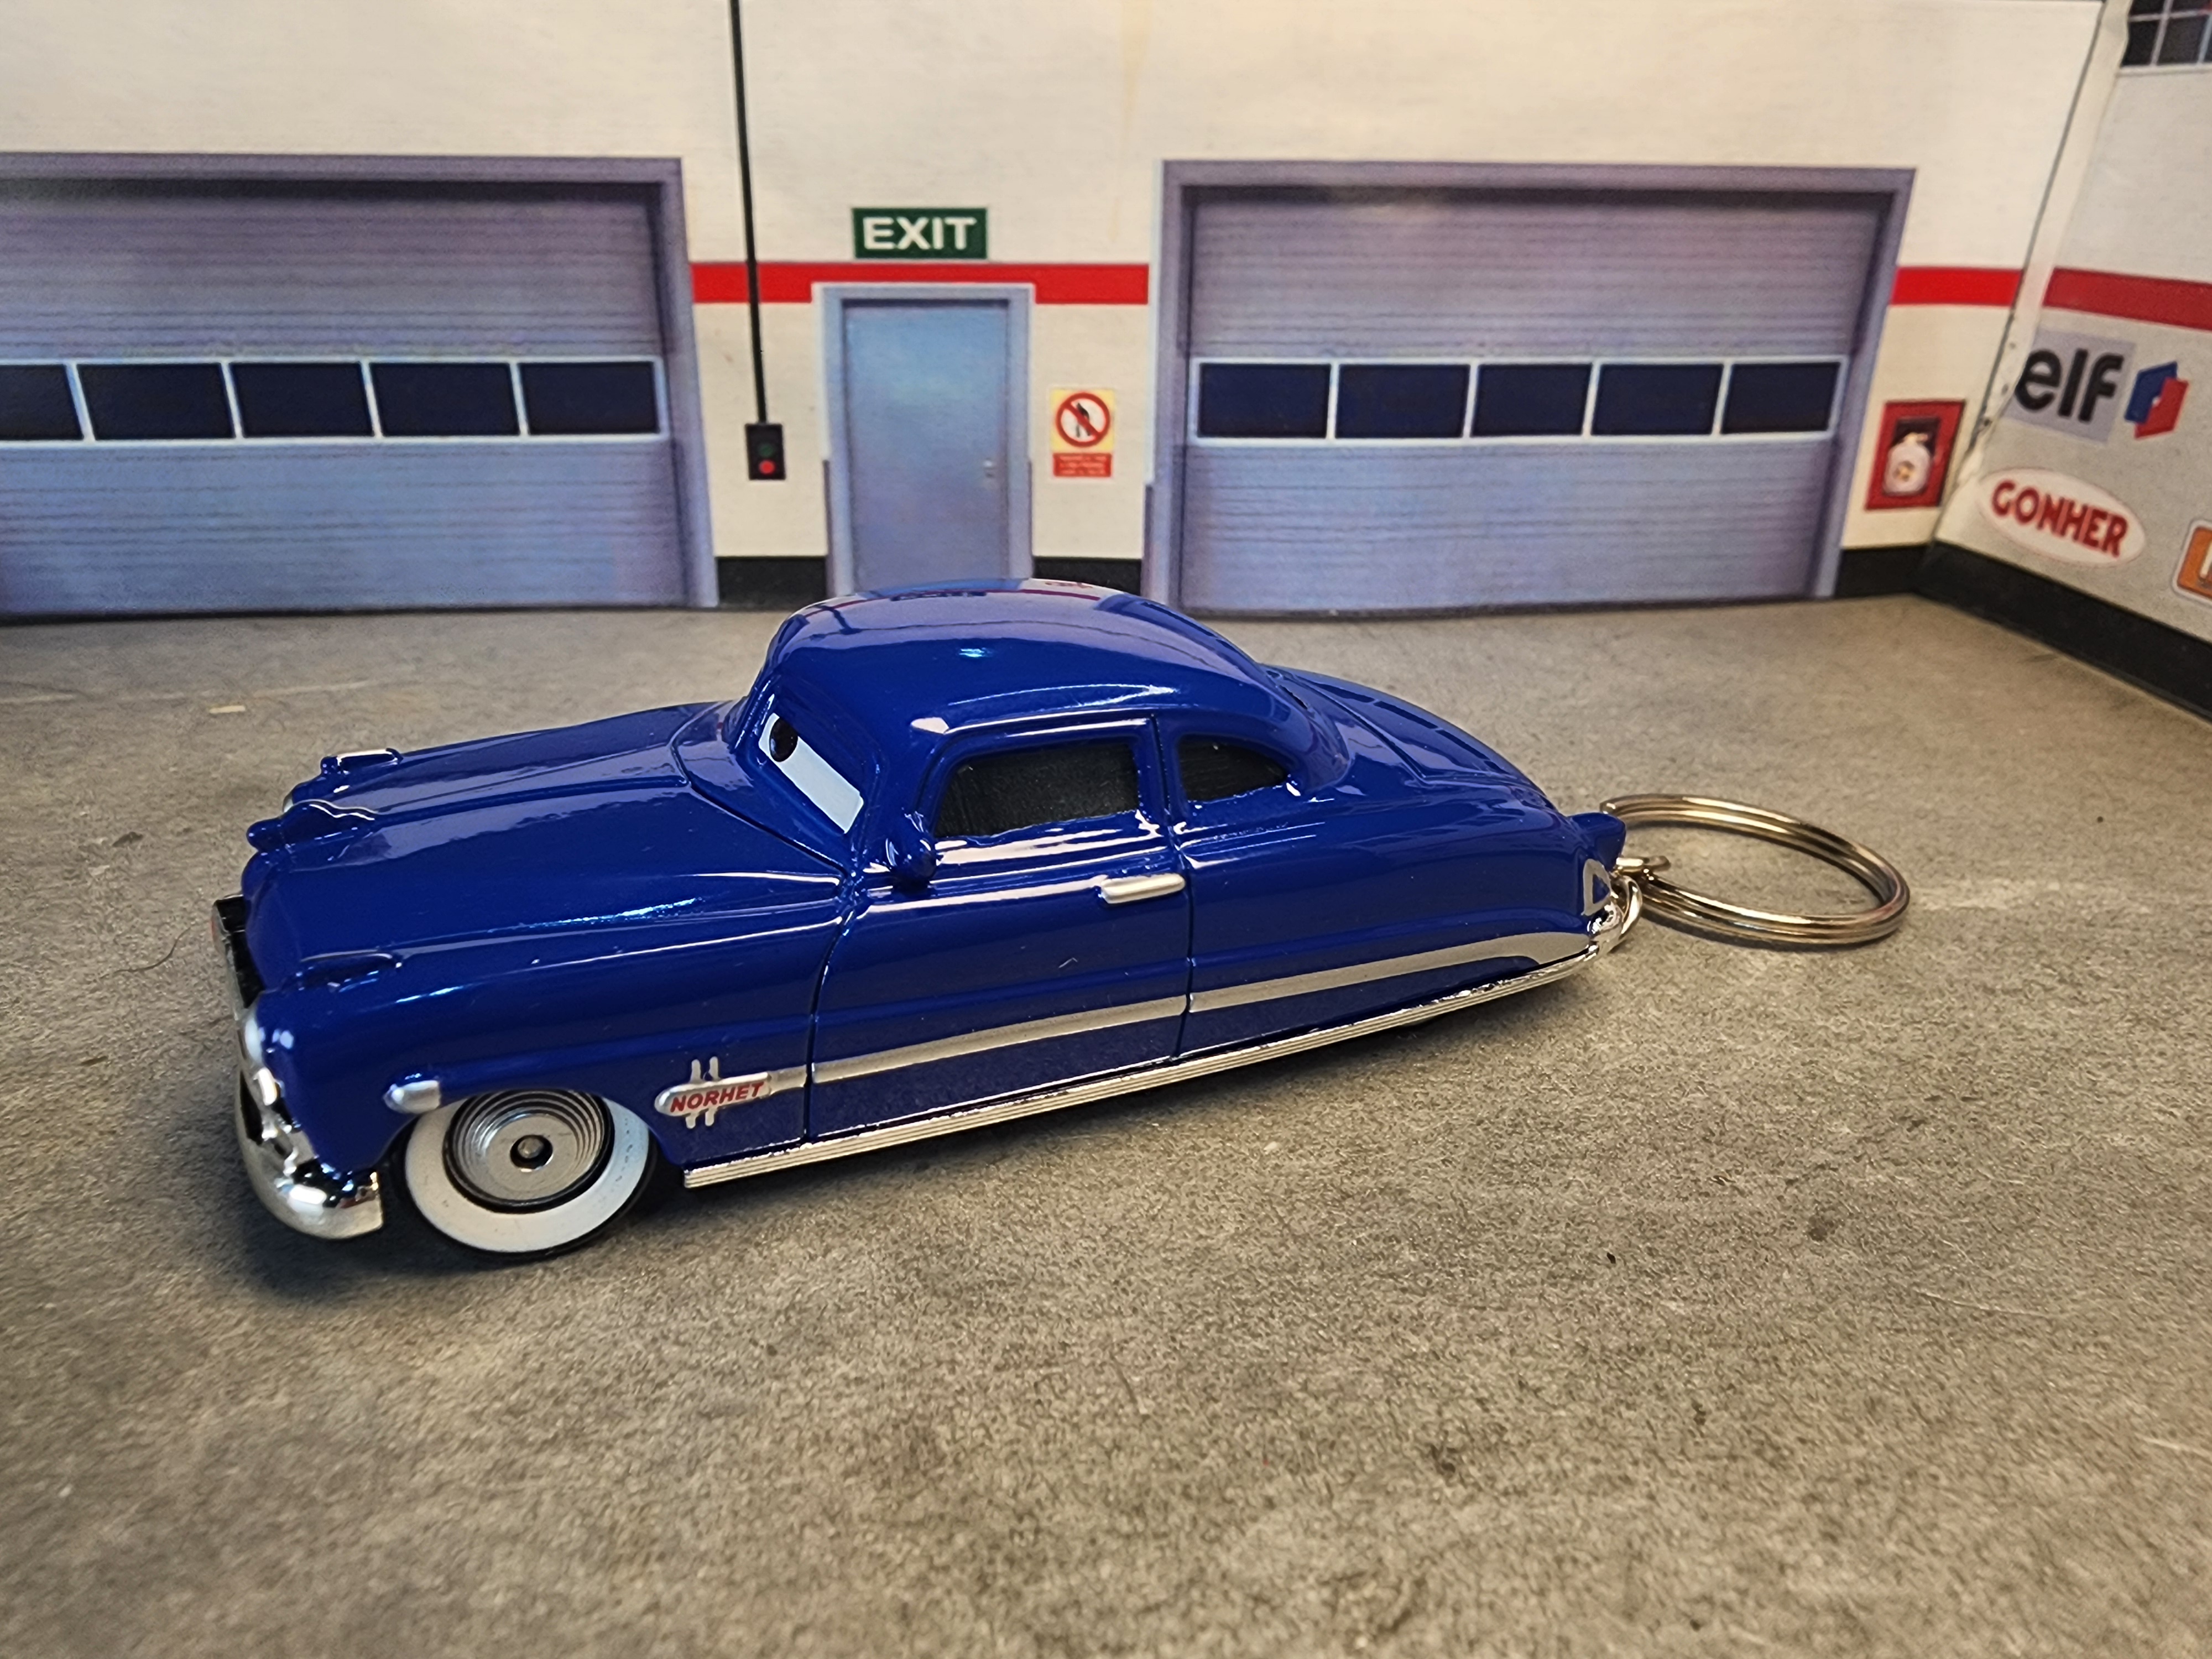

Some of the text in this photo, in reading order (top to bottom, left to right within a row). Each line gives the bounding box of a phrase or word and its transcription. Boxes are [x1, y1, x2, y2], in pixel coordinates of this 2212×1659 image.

[863, 216, 977, 250] EXIT
[2014, 348, 2125, 425] elf
[670, 1081, 764, 1113] NORHET
